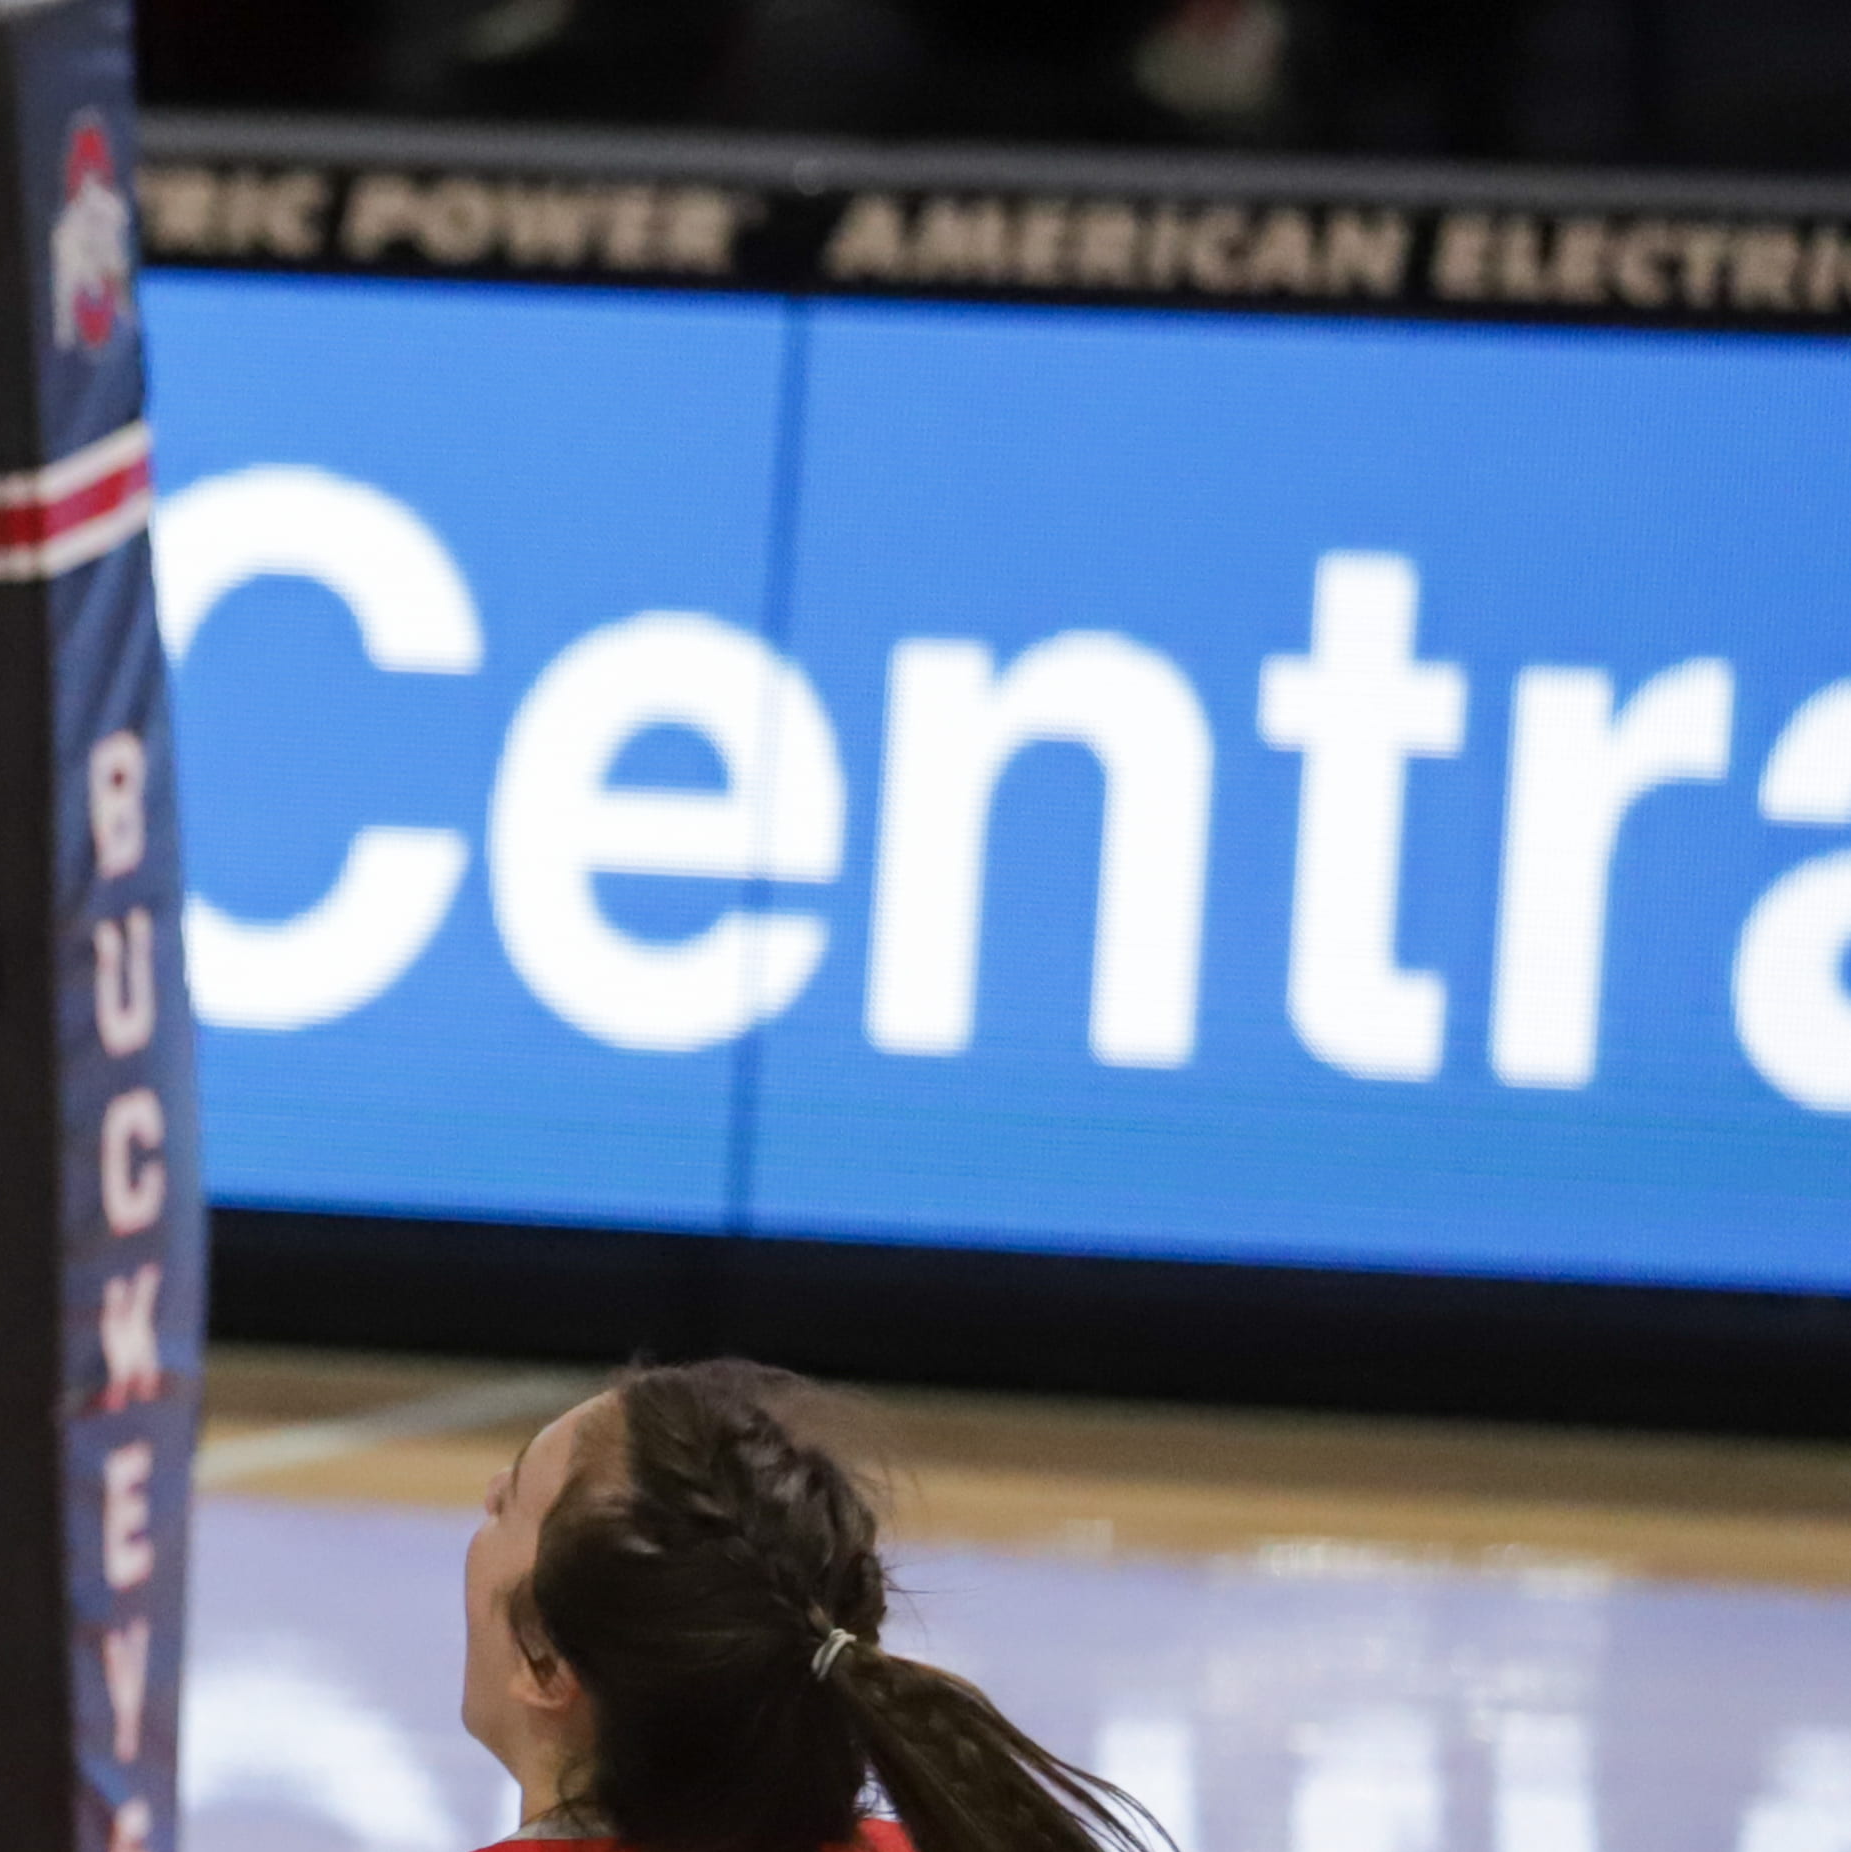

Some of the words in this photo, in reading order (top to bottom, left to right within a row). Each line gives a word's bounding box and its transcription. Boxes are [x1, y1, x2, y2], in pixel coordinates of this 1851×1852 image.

[337, 170, 737, 276] POWER
[822, 194, 1409, 302] AMERICAN
[1431, 210, 1851, 314] ELECTRI
